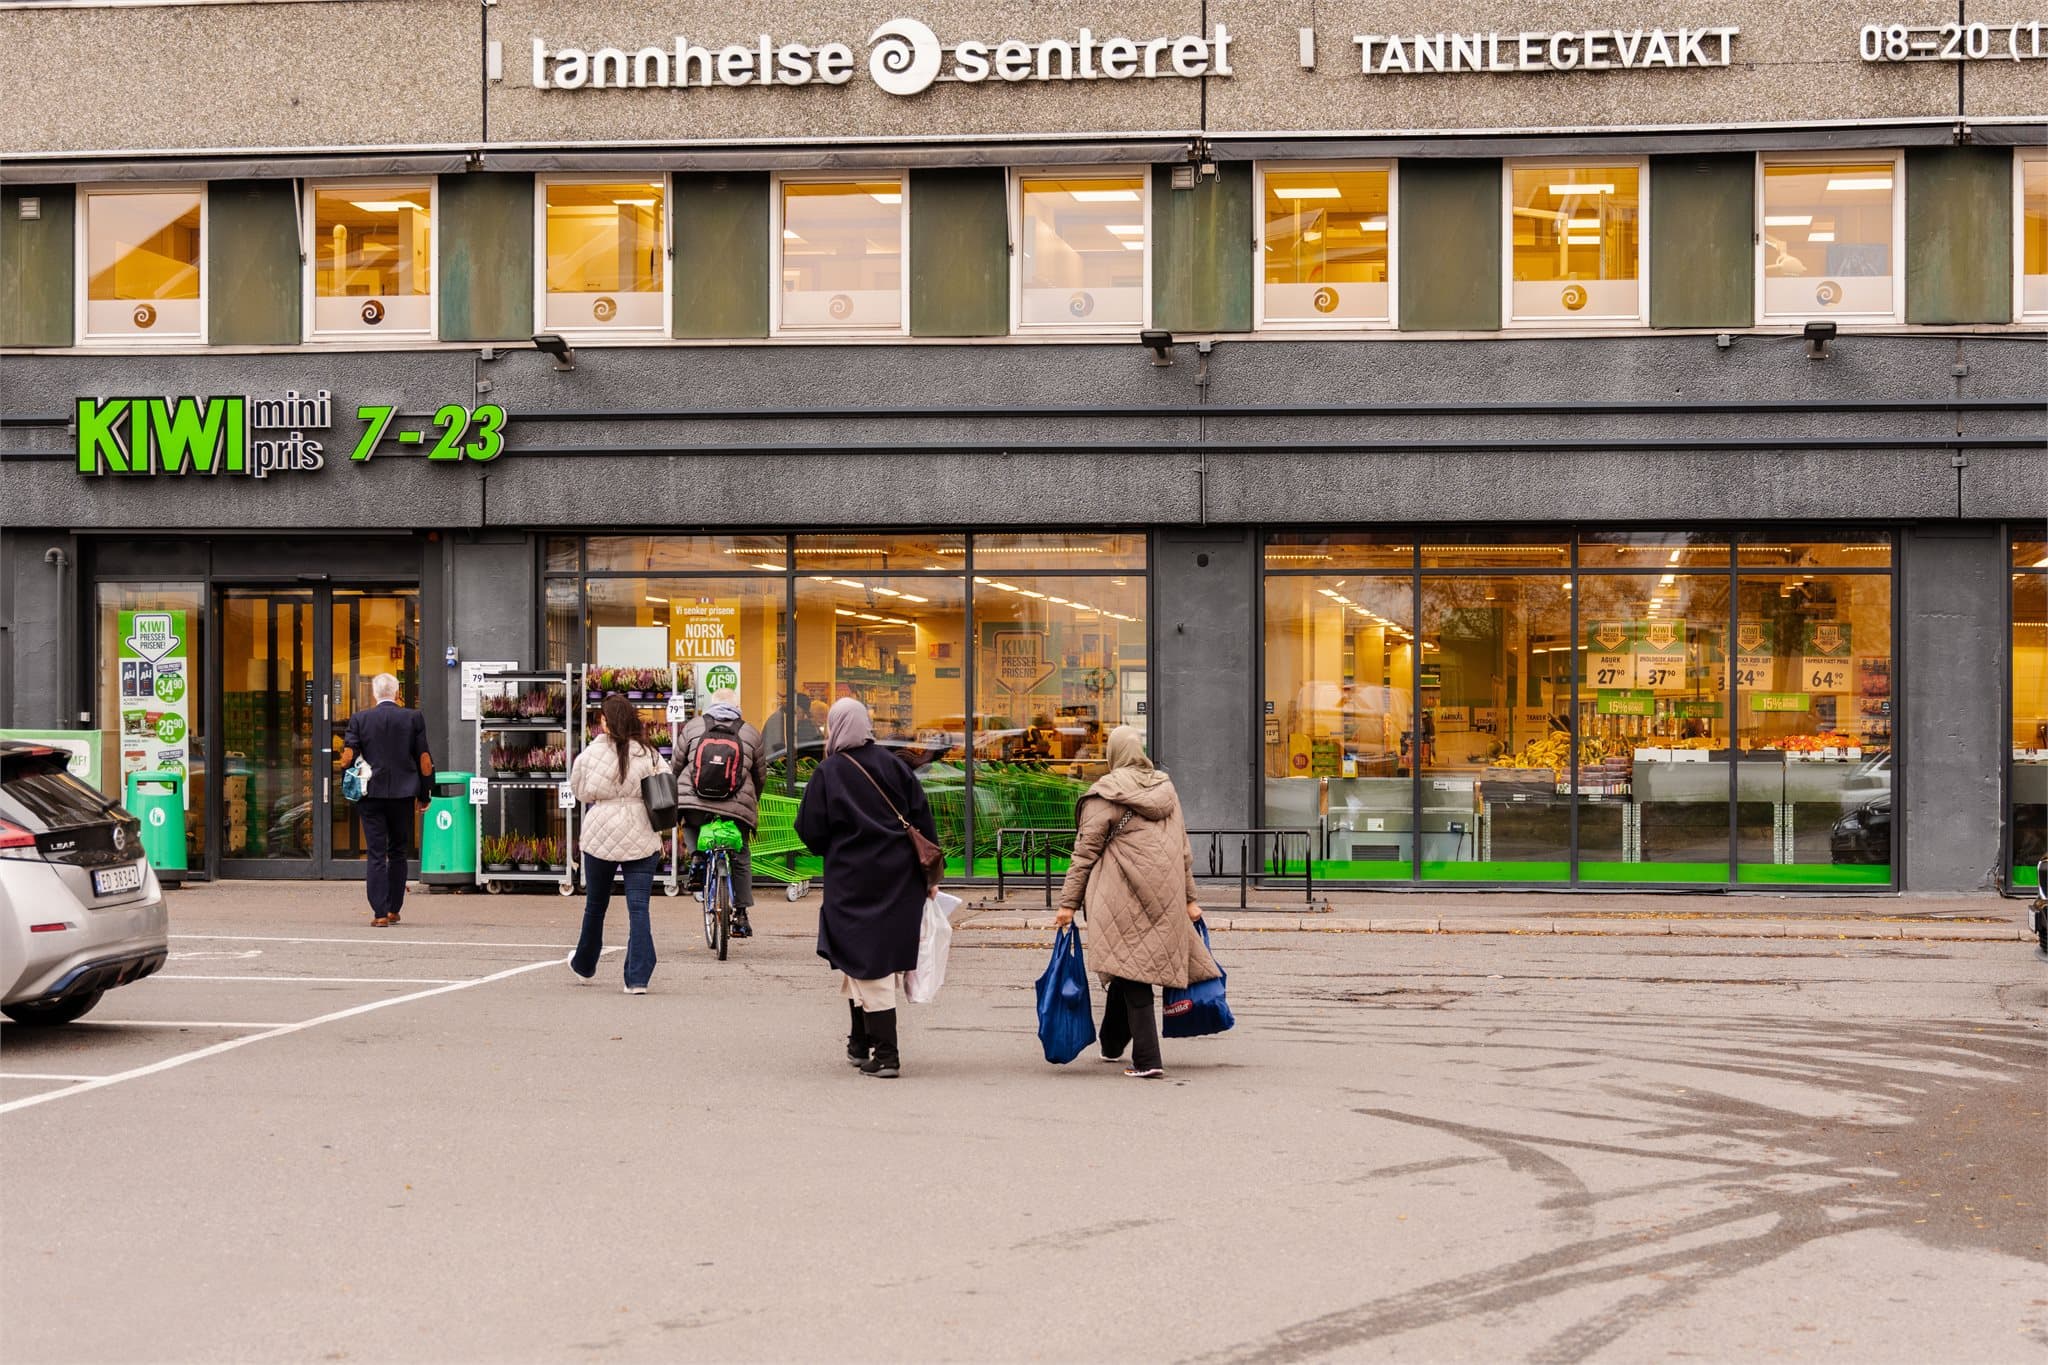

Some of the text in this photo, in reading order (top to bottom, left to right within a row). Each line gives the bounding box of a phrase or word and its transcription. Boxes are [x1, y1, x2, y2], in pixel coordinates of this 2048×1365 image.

[533, 23, 1232, 89] tannhelse senteret
[1353, 26, 1739, 74] TANNLEGEVAKT
[255, 390, 332, 428] mini
[77, 396, 250, 475] KIWI
[255, 433, 324, 478] pris
[676, 606, 735, 616] Vi senker prisene
[140, 620, 165, 632] KIWI
[685, 623, 725, 639] NORSK
[140, 632, 166, 640] PRESSER
[140, 641, 166, 650] PRISENE!
[675, 639, 735, 657] KYLLING
[1001, 639, 1036, 655] KIWI
[1001, 656, 1037, 667] PRESSER
[1001, 667, 1037, 678] PRISENE!
[51, 841, 76, 850] LEAF
[114, 868, 139, 889] 38342
